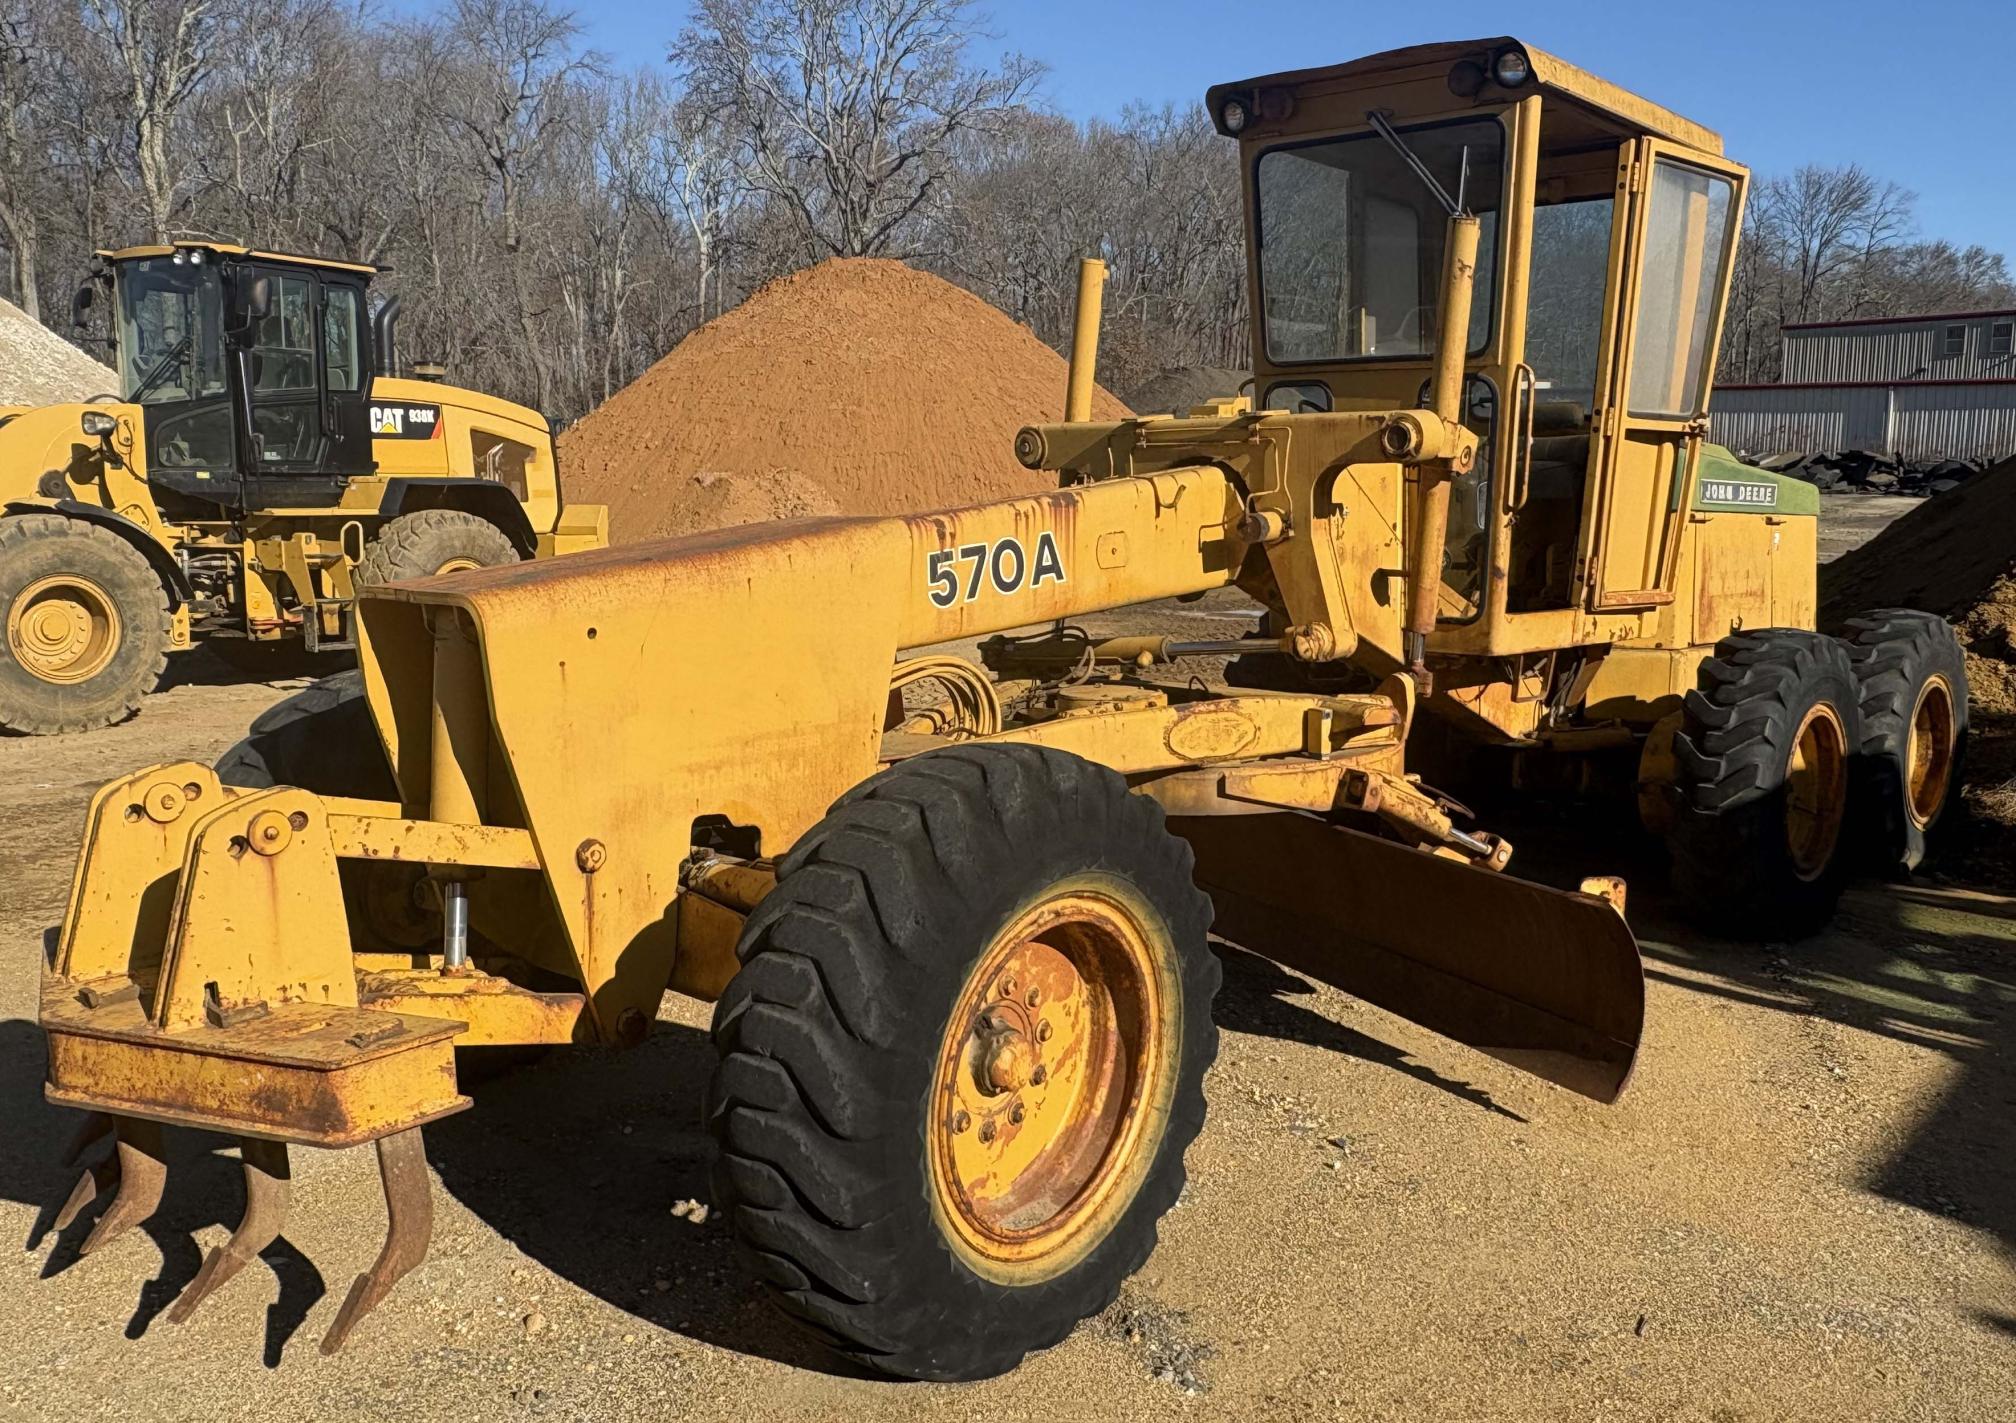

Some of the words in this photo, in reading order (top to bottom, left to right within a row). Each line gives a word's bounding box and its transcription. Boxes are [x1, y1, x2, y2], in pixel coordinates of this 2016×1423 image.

[369, 406, 404, 433] CAT
[408, 409, 435, 423] 938K
[1705, 483, 1733, 500] JOHN
[1738, 485, 1773, 502] DEERE
[927, 530, 1067, 609] 570A
